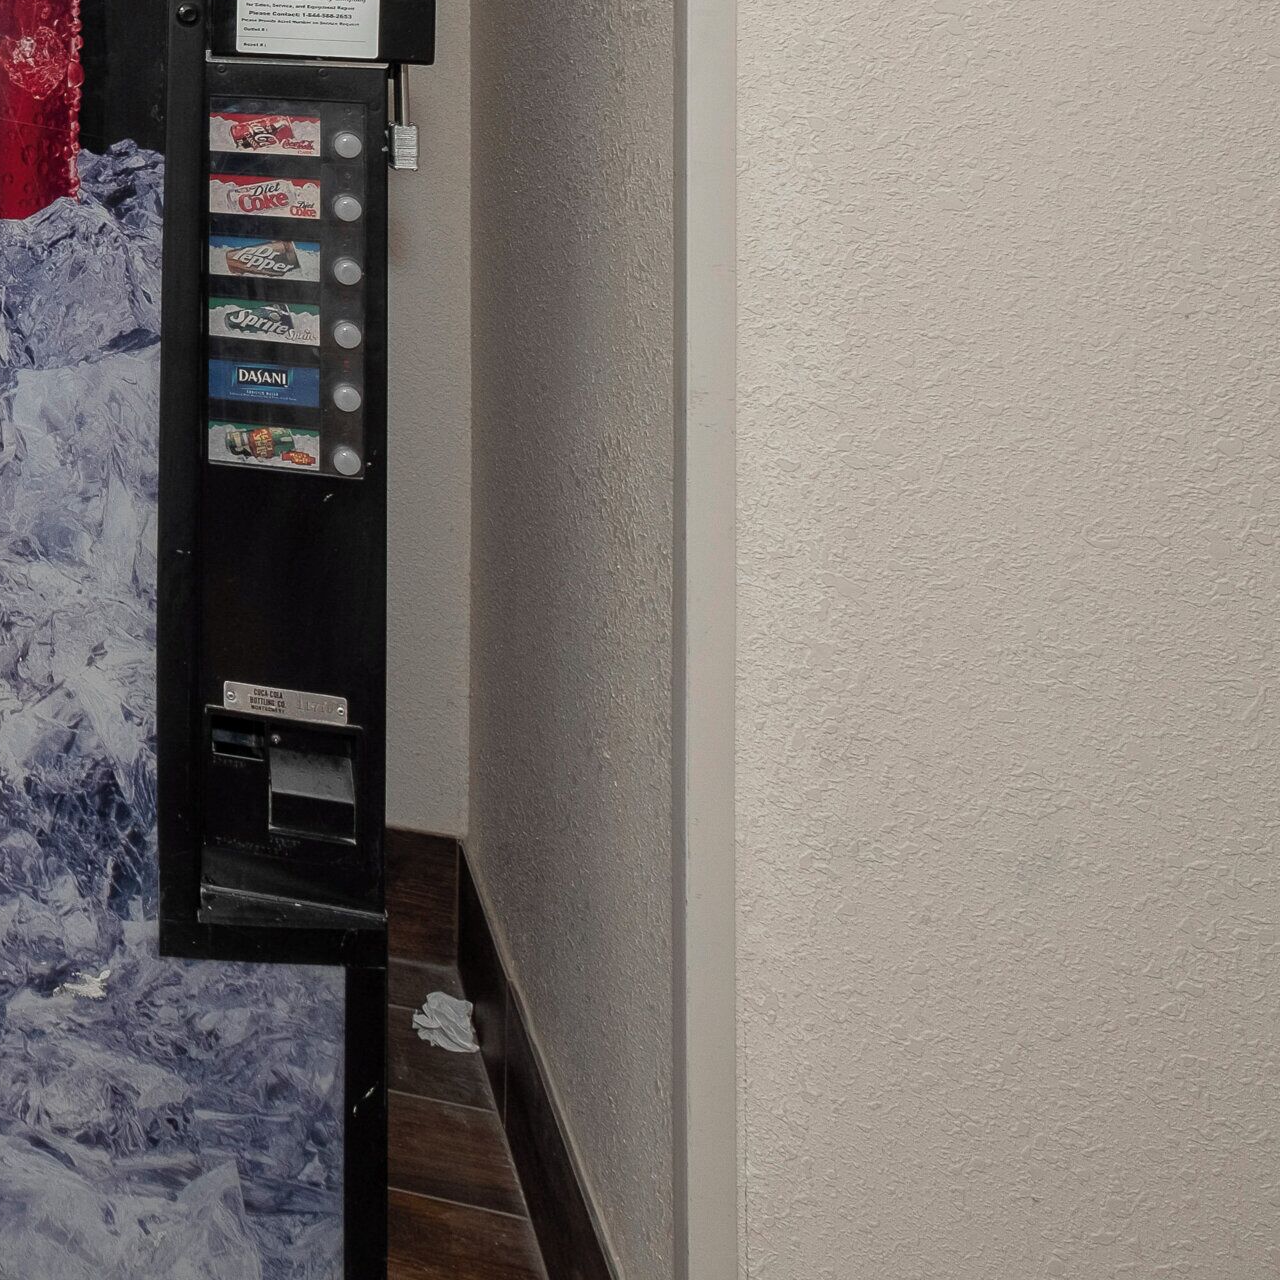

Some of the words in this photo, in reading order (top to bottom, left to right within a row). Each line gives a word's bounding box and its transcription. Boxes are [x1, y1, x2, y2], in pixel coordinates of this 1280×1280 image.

[238, 192, 289, 213] Coke
[232, 247, 295, 272] Pepper
[253, 245, 280, 260] Dr
[229, 309, 289, 335] Sprite
[238, 368, 289, 388] DASANI
[250, 696, 275, 707] BOTTLING
[253, 688, 268, 696] COCA
[269, 690, 283, 699] COLA
